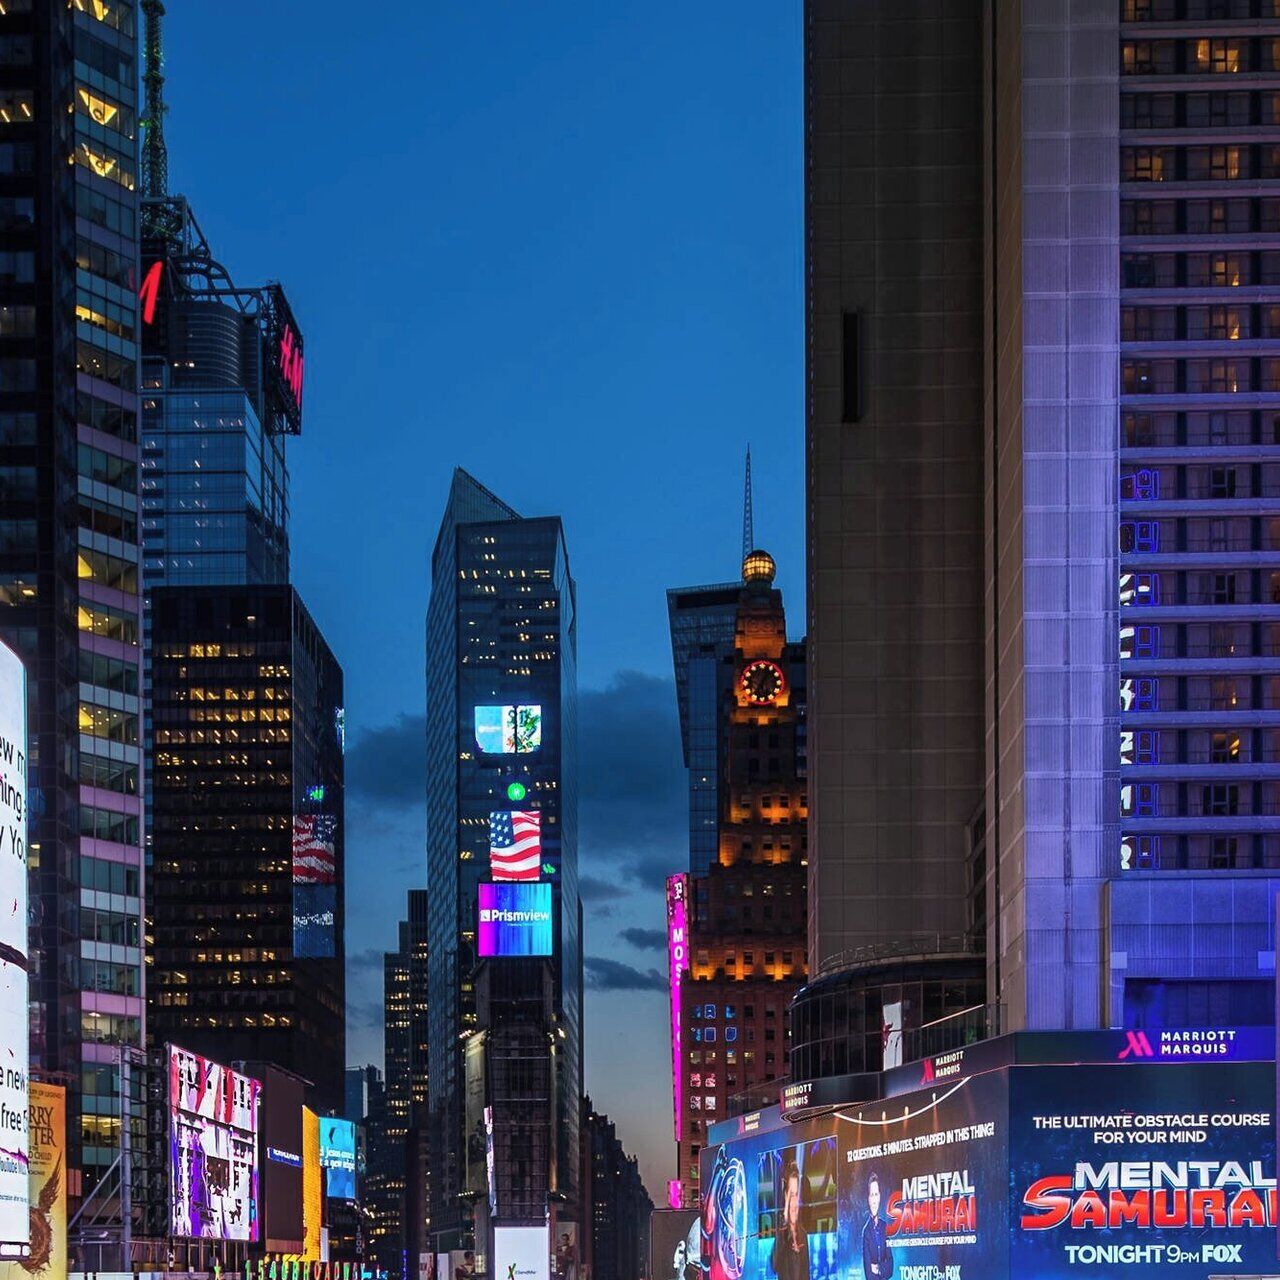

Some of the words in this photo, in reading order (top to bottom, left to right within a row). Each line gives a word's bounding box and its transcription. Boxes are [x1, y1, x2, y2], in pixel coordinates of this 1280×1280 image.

[491, 909, 549, 924] Prismview
[1160, 1030, 1237, 1043] MARRIOTT
[1160, 1042, 1228, 1055] MARQUIS
[935, 1050, 964, 1067] MARRIOTT
[935, 1064, 961, 1078] MARQUIS
[1, 1103, 22, 1131] free
[1032, 1115, 1060, 1129] THE
[1064, 1114, 1131, 1129] ULTIMATE
[1135, 1114, 1206, 1129] OBSTACLE
[1210, 1113, 1271, 1128] COURSE
[902, 1169, 975, 1200] MENTAL
[1074, 1162, 1277, 1191] MENTAL
[885, 1190, 977, 1236] SAMURAI
